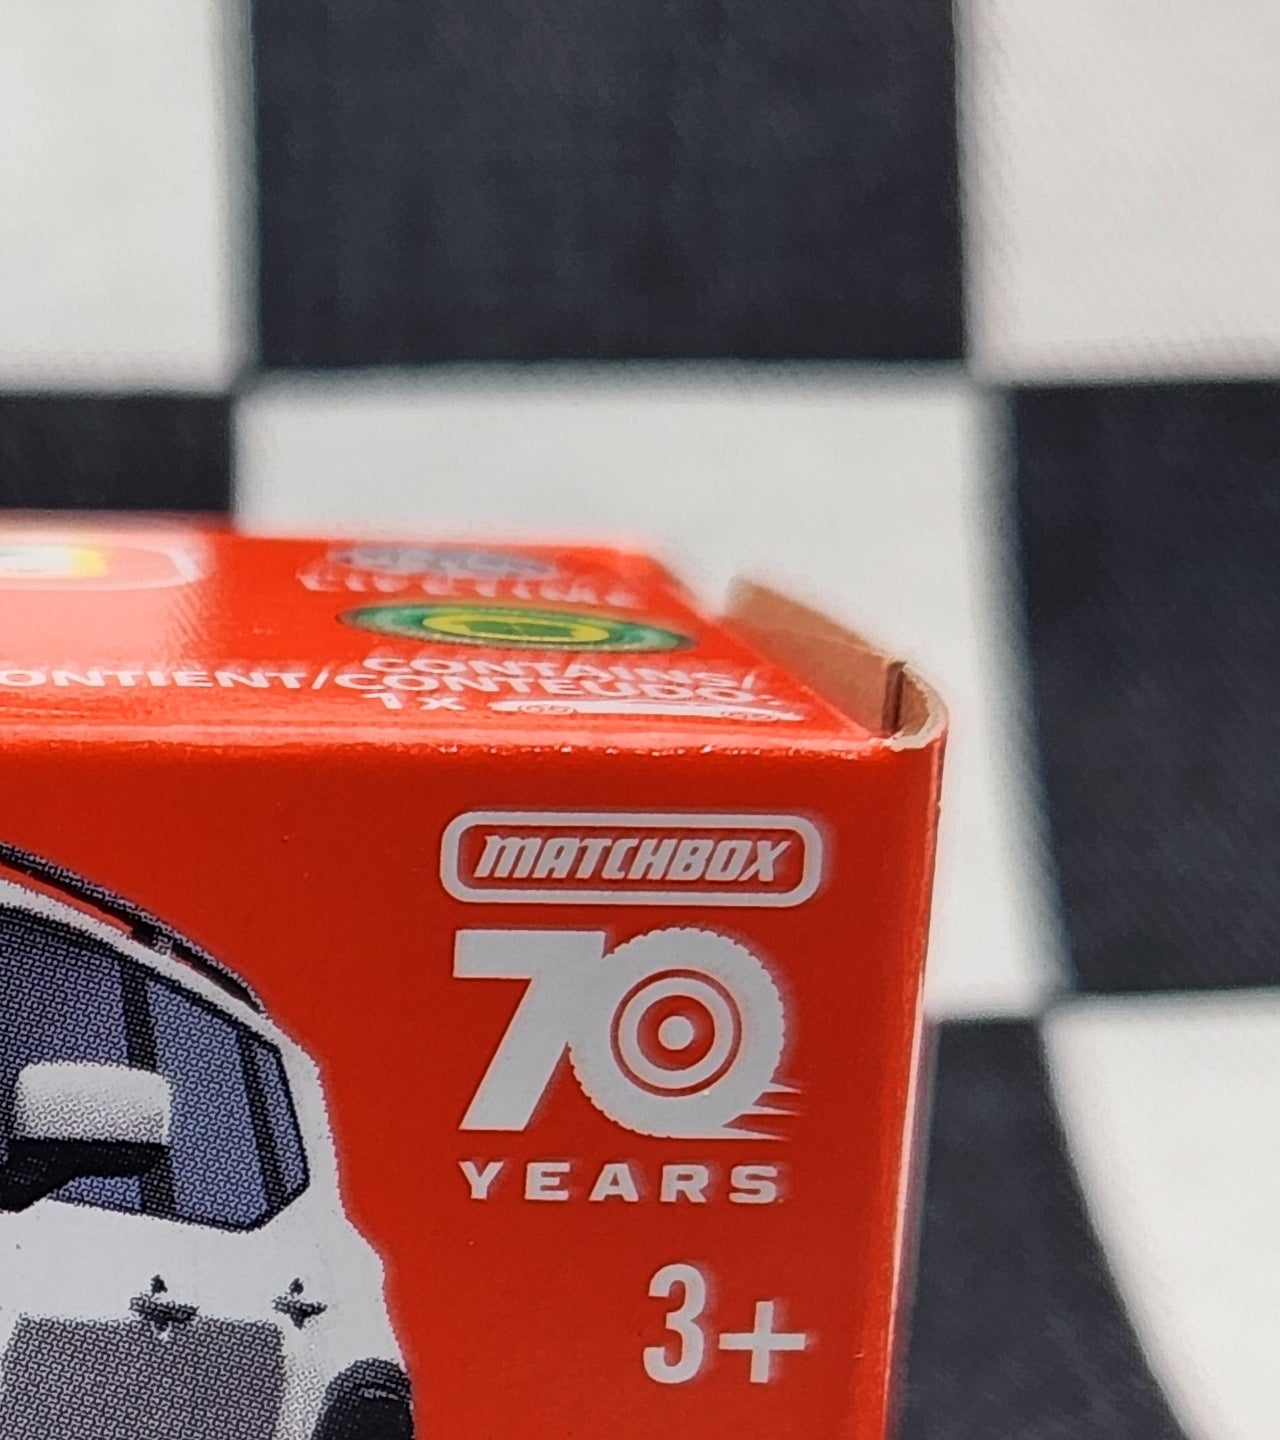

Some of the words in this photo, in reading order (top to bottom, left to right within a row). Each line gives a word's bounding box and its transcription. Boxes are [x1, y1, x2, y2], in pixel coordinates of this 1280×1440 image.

[474, 834, 792, 881] MATCHBOX
[453, 925, 790, 1140] 70
[458, 1161, 780, 1204] YEARS
[642, 1263, 807, 1385] 3+
